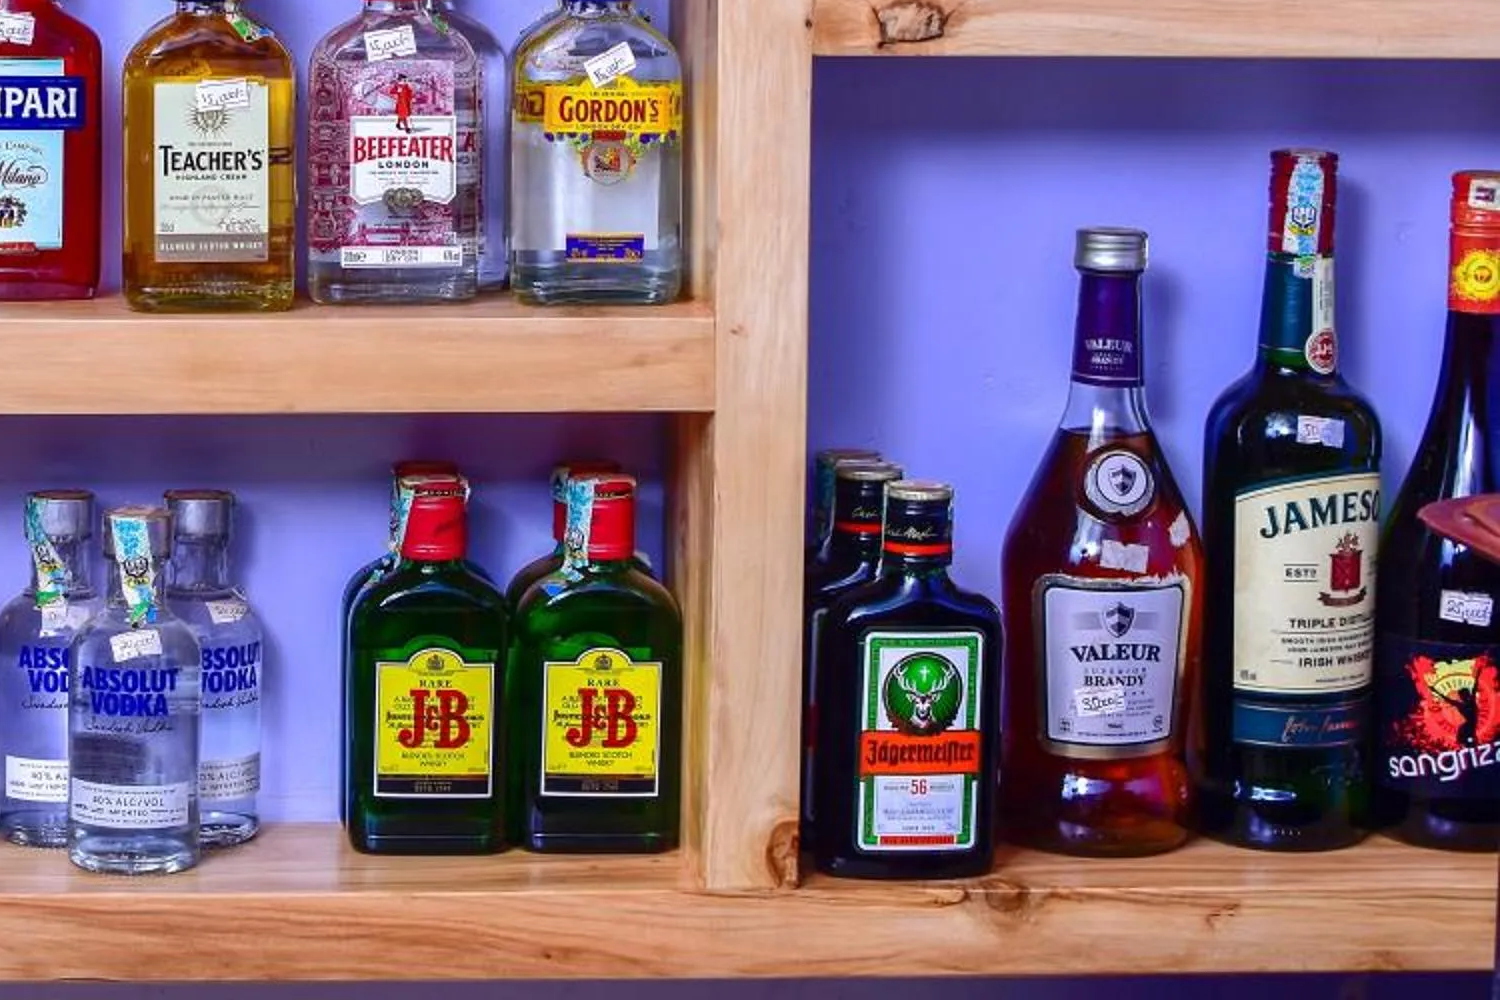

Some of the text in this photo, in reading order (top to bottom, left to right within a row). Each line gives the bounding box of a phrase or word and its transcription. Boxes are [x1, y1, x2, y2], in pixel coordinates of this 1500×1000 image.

[558, 95, 661, 124] GORDON'S
[352, 135, 455, 164] BEEFEATER
[158, 144, 264, 177] TEACHER'S
[377, 160, 430, 169] LONDON
[1288, 618, 1336, 629] TRIPLE
[1070, 642, 1161, 663] VALEUR
[1298, 657, 1334, 668] IRISH
[82, 666, 183, 693] ABSOLUT
[419, 679, 454, 688] RARE
[586, 678, 621, 687] RARE
[1083, 674, 1146, 687] BRANDY
[90, 691, 169, 717] VODKA
[910, 779, 928, 795] 56
